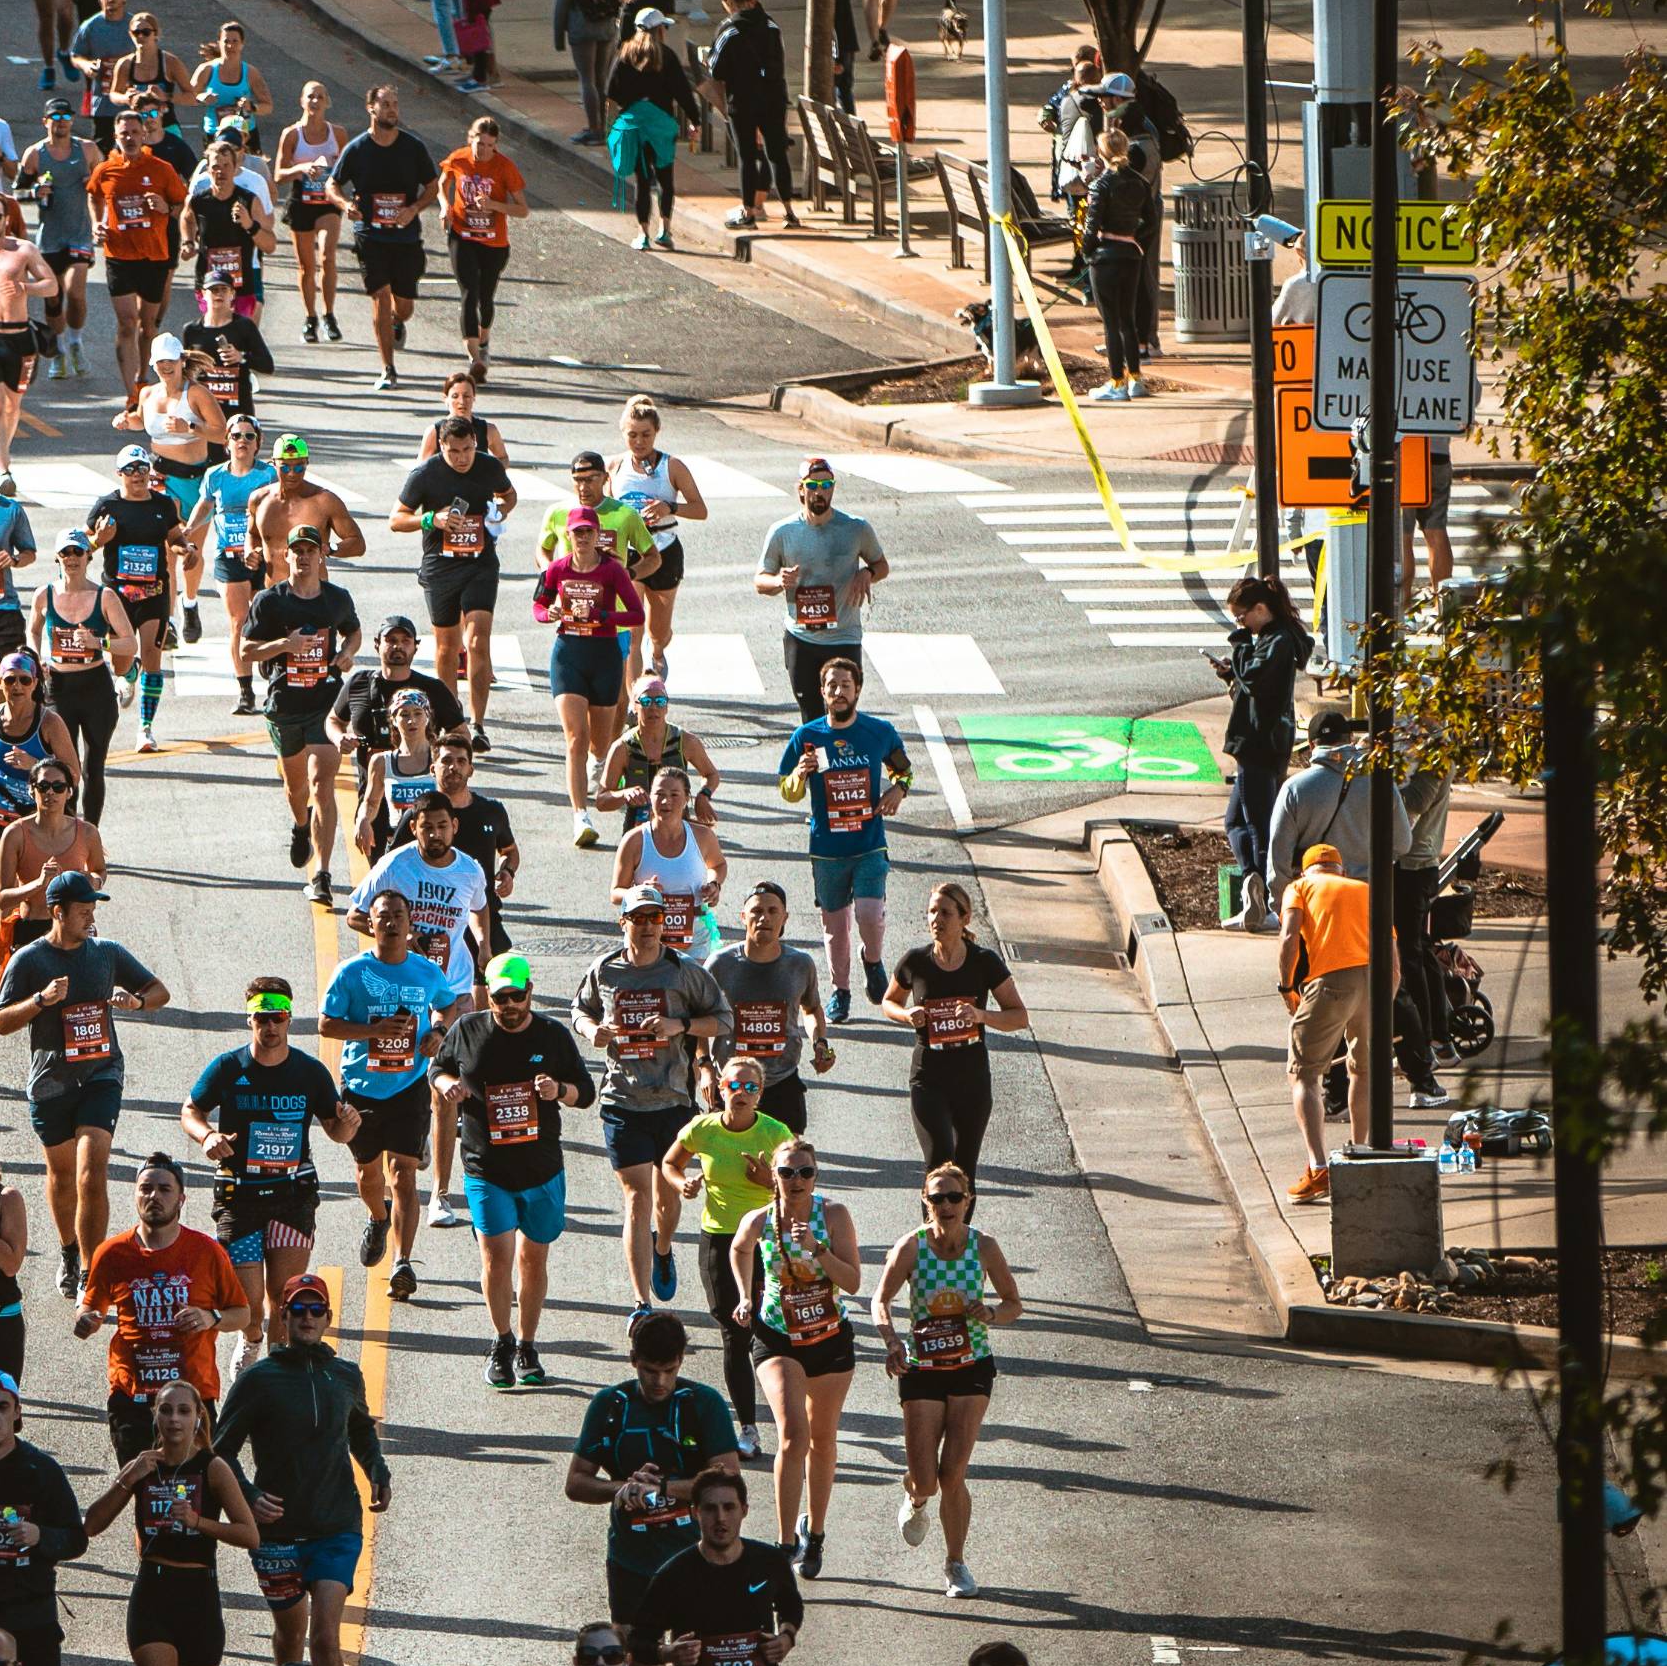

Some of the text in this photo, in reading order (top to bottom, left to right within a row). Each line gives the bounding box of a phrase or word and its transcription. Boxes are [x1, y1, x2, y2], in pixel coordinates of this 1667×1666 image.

[1407, 360, 1450, 382] USE
[1403, 397, 1461, 420] LANE
[450, 534, 477, 542] 2276
[123, 561, 153, 572] 21326
[801, 605, 829, 614] 4430
[831, 754, 870, 767] ANSAS
[832, 789, 866, 801] 14142
[418, 881, 456, 903] 1907
[73, 1023, 101, 1037] 1808
[741, 1022, 781, 1033] 14805
[377, 1038, 410, 1048] 3208
[496, 1106, 529, 1119] 2338
[256, 1144, 294, 1155] 21917
[134, 1286, 189, 1307] NASH
[135, 1307, 176, 1323] VILL
[795, 1304, 824, 1320] 1616
[921, 1335, 964, 1352] 13639
[139, 1367, 180, 1381] 14126
